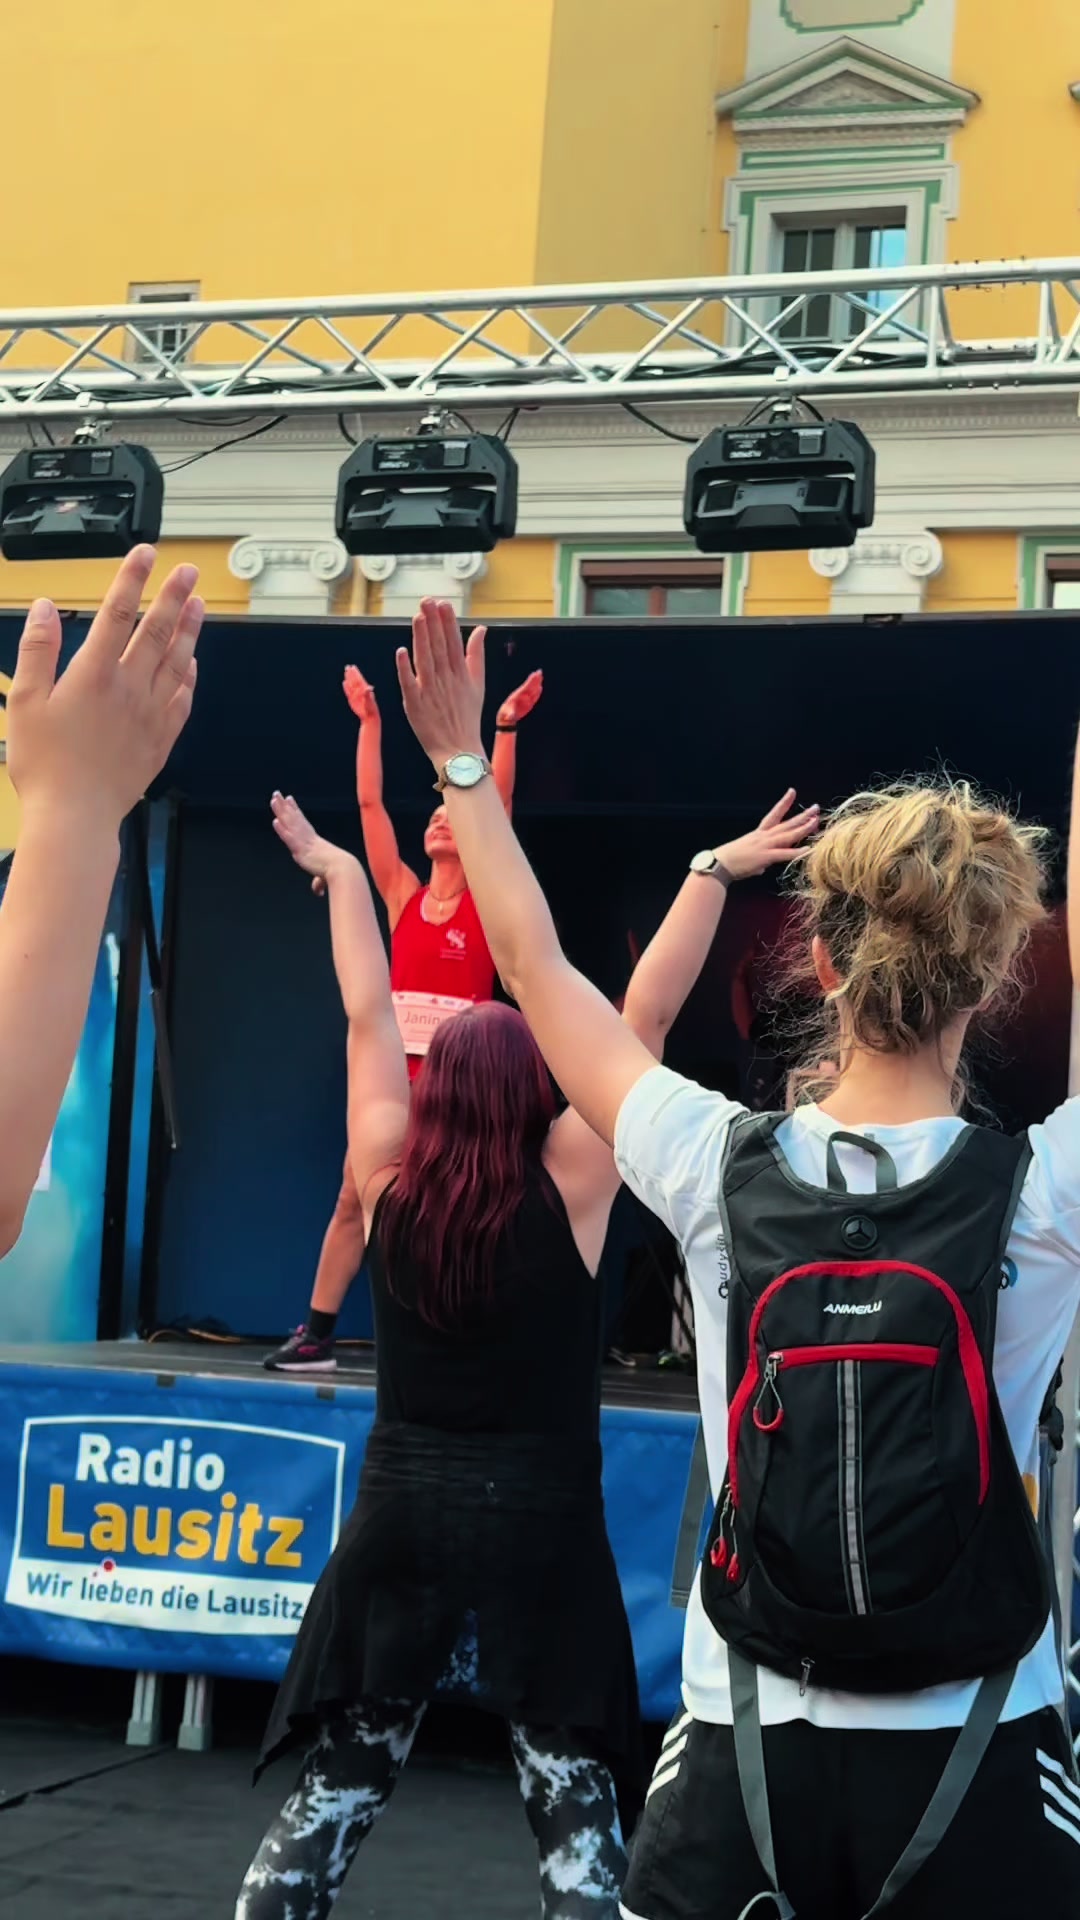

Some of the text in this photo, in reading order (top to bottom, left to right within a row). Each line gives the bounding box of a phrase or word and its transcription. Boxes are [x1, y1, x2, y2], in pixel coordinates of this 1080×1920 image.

[403, 1010, 443, 1025] Janin
[75, 1432, 226, 1492] Radio
[46, 1483, 304, 1568] Lausitz
[27, 1571, 304, 1620] Wir lieben die Lausitz
